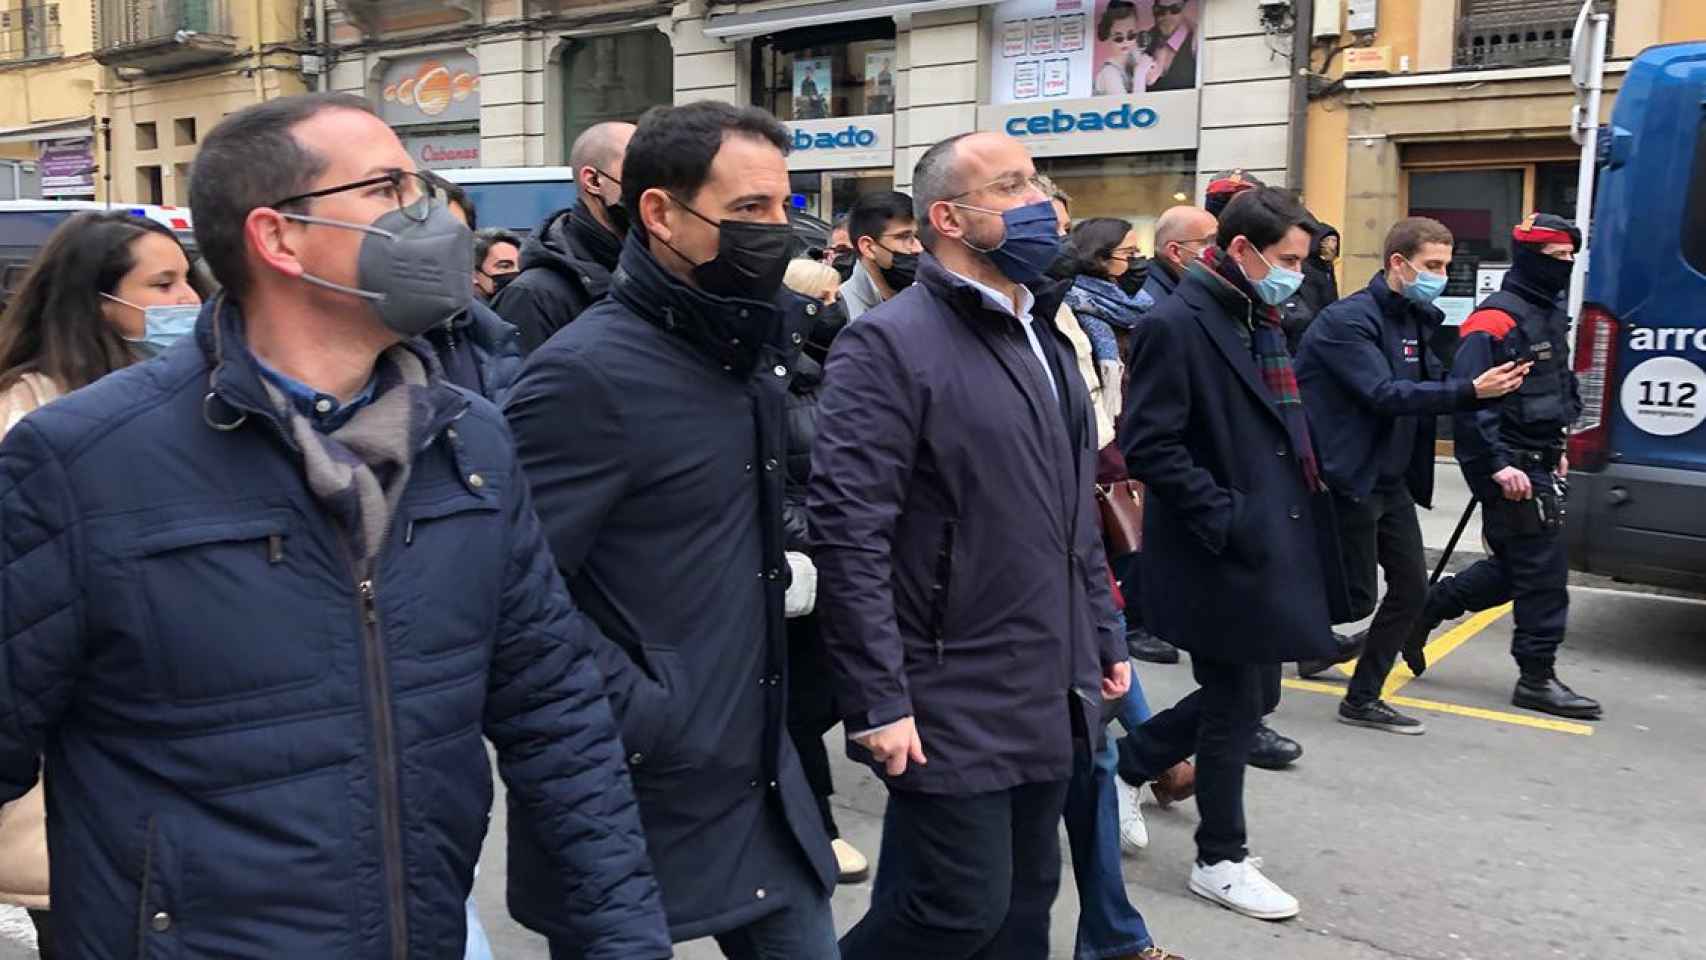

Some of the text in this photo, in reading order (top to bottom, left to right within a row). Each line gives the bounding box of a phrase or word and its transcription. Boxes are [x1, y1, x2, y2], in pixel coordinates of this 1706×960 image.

[1005, 103, 1157, 136] cebado
[791, 125, 876, 151] bado
[1638, 381, 1697, 408] 112
